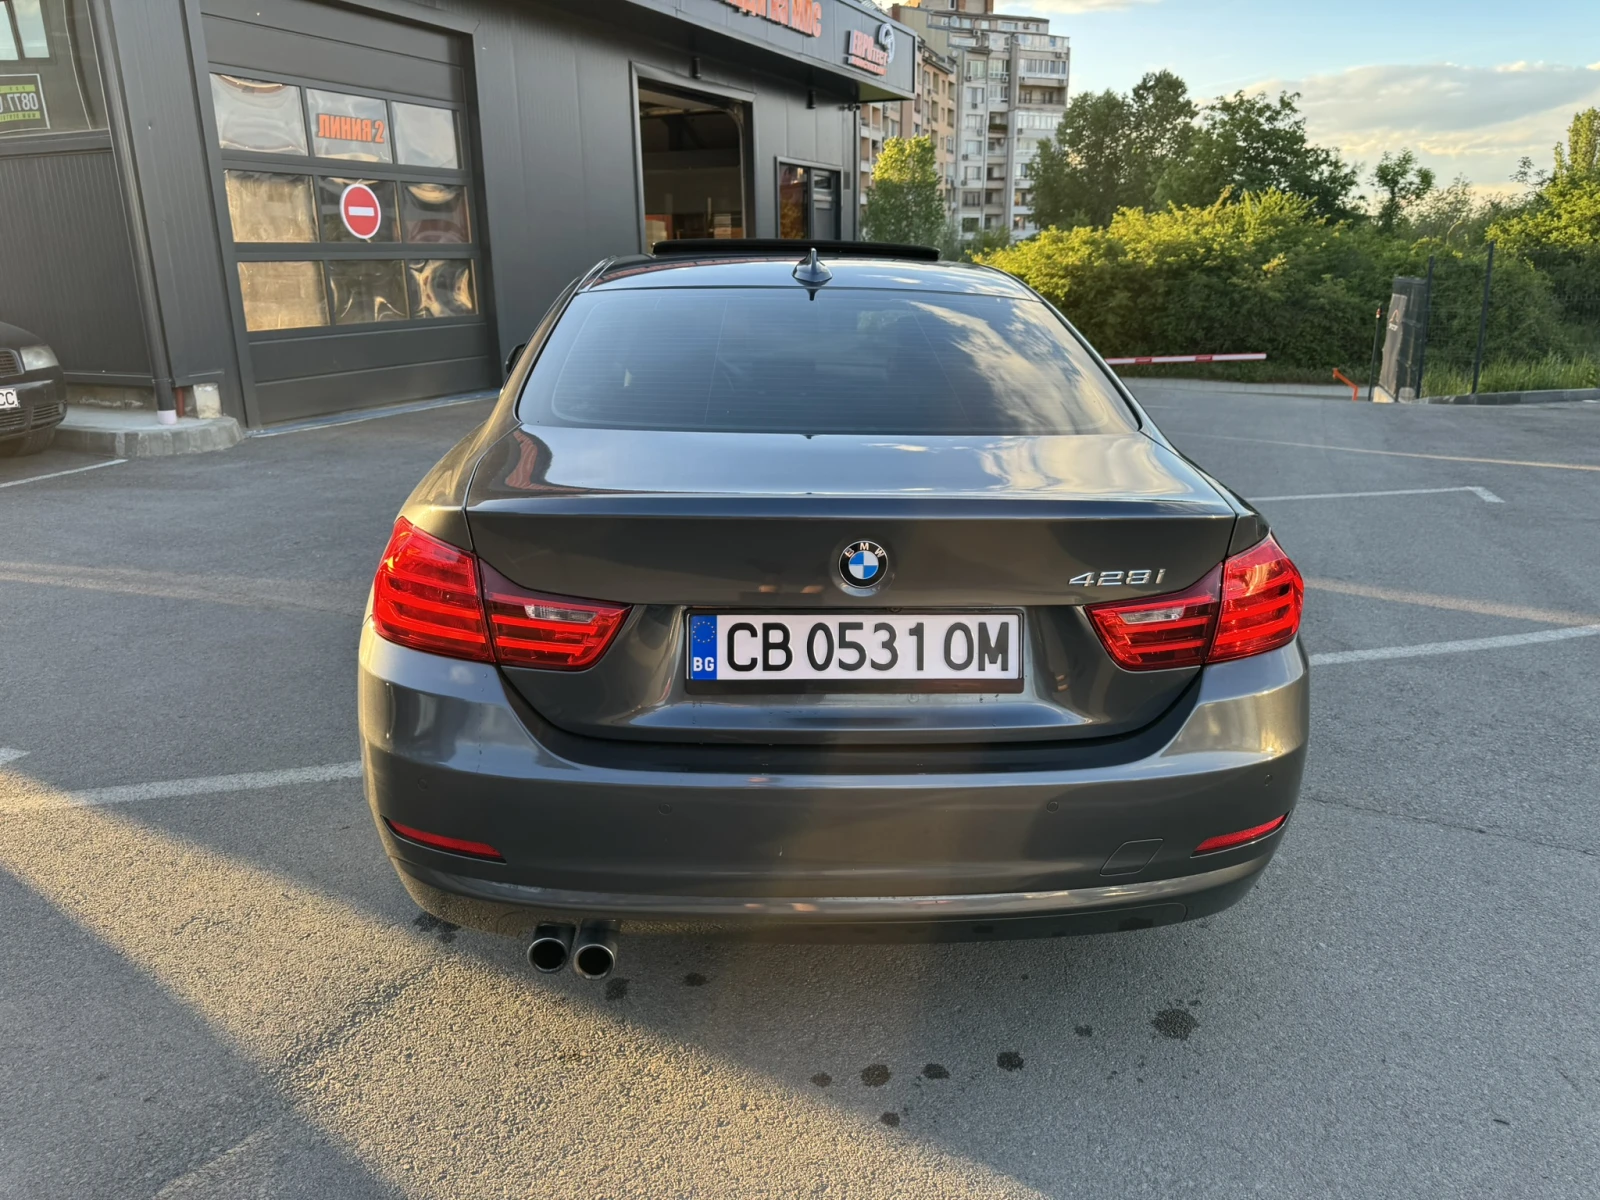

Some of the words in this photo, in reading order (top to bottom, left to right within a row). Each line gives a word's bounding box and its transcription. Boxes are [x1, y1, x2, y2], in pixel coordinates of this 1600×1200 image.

[317, 114, 372, 142] ЛИНИЯ
[374, 120, 385, 143] 2
[844, 542, 886, 558] BMW
[1068, 568, 1166, 587] 428i
[727, 622, 793, 672] CB
[807, 622, 924, 671] 0531
[944, 622, 1009, 671] OM
[693, 657, 715, 671] BG
